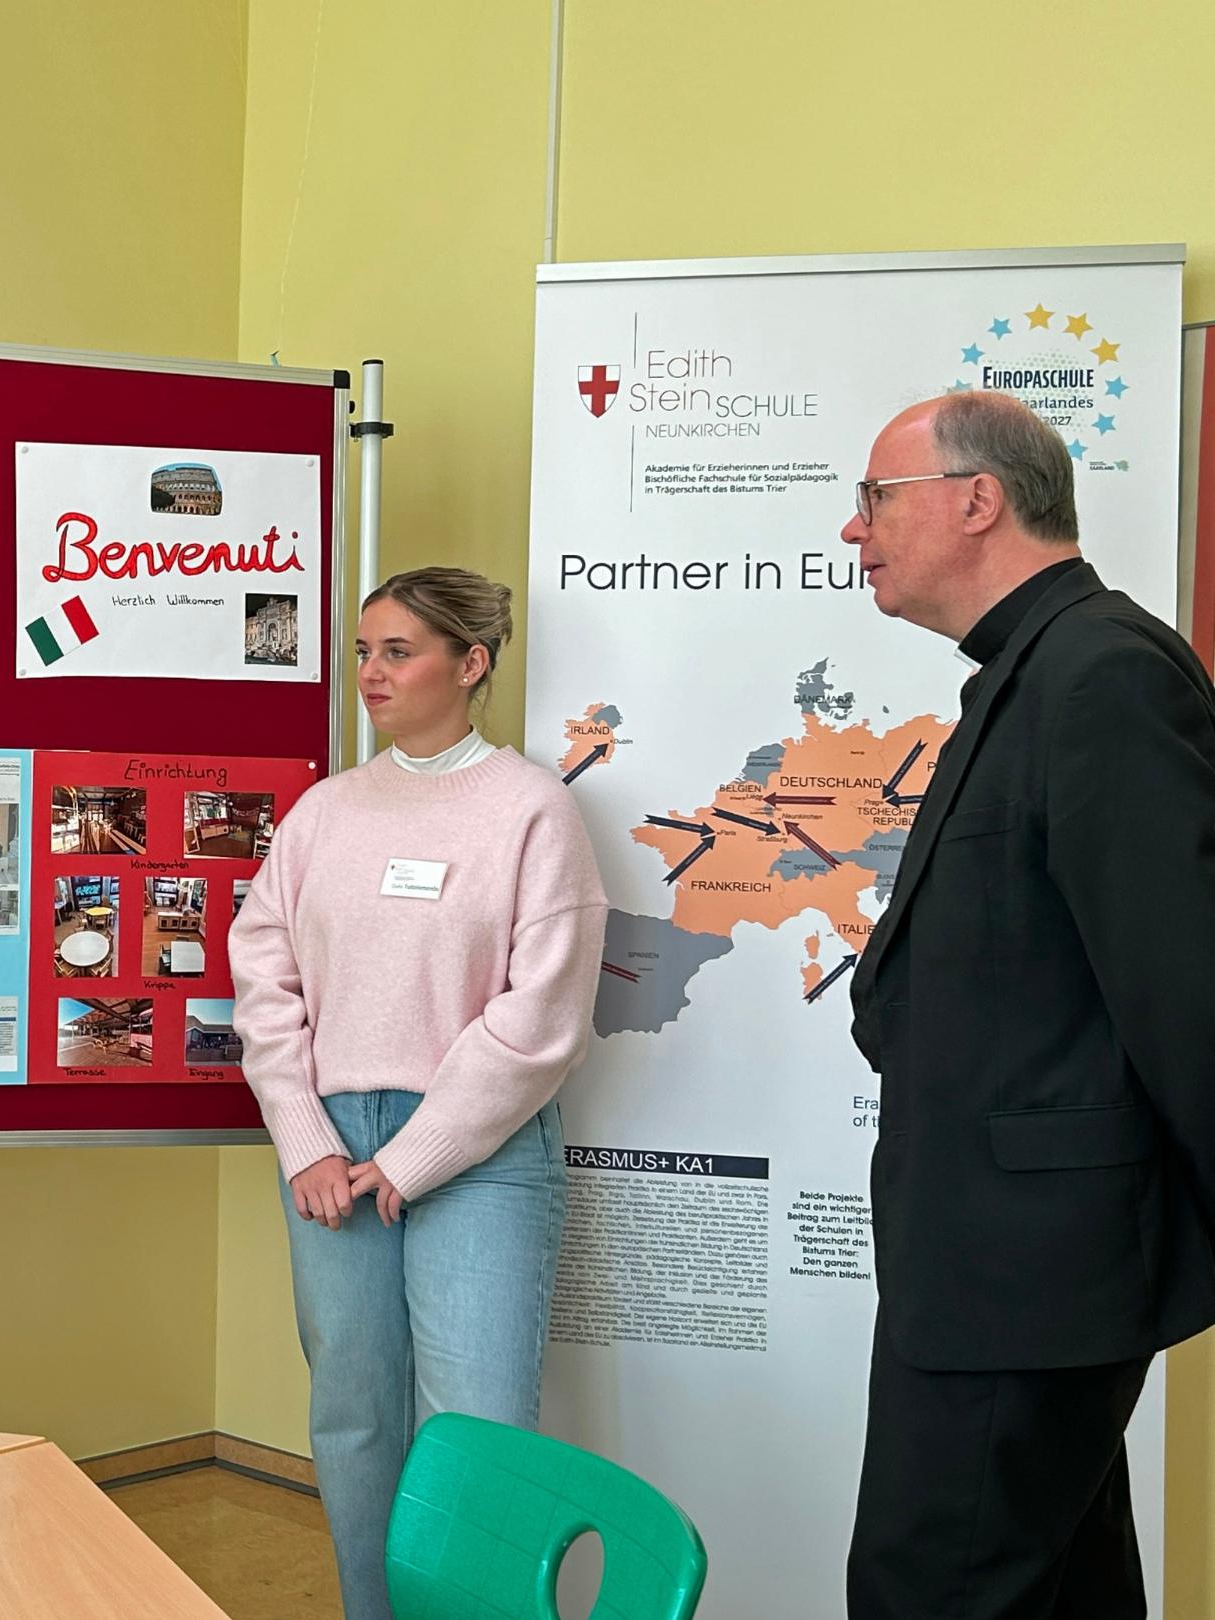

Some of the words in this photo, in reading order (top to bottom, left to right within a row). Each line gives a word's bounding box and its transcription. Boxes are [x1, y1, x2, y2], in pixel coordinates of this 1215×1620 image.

[648, 350, 732, 378] Edith
[1017, 396, 1094, 409] aarlandes
[646, 423, 761, 438] NEUNKIRCHEN
[645, 464, 690, 473] Akademie
[692, 464, 705, 472] für
[708, 463, 770, 472] Erzieherinnen
[772, 463, 789, 472] und
[792, 462, 830, 471] Erzieher
[645, 474, 696, 484] Bischöfliche
[698, 474, 746, 483] Fachschule
[748, 474, 762, 482] für
[764, 472, 839, 483] Sozialpädagogik
[645, 486, 653, 494] in
[656, 485, 711, 496] Trägerschaft
[712, 486, 728, 494] des
[730, 485, 764, 493] Bistums
[766, 485, 788, 493] Trier
[41, 511, 305, 583] Benvenuti
[560, 554, 728, 590] Partner
[745, 553, 782, 590] in
[112, 594, 156, 607] Herzlich
[166, 595, 225, 607] Willkommen
[570, 726, 610, 735] IRLAND
[125, 759, 228, 787] Einrichtung
[720, 784, 762, 792] BELGIEN
[780, 776, 883, 789] DEUTSCHLAND
[130, 859, 189, 872] Kindergarten
[691, 880, 772, 892] FRANKREICH
[144, 980, 176, 990] Krippe
[63, 1068, 107, 1076] Terrasse
[188, 1068, 224, 1080] Eingang
[853, 1115, 868, 1126] of
[564, 1148, 669, 1170] RASMUS+
[676, 1156, 713, 1174] KA1
[800, 1191, 825, 1200] Beide
[828, 1193, 864, 1202] Projekte
[830, 1205, 871, 1215] wichtiger
[788, 1212, 818, 1223] Beitrag
[816, 1225, 852, 1234] Schulen
[794, 1234, 849, 1245] Trägerschaft
[802, 1246, 836, 1255] Bistums
[803, 1257, 821, 1265] Den
[824, 1260, 858, 1268] ganzen
[790, 1267, 836, 1278] Menschen
[839, 1270, 871, 1280] bilden!
